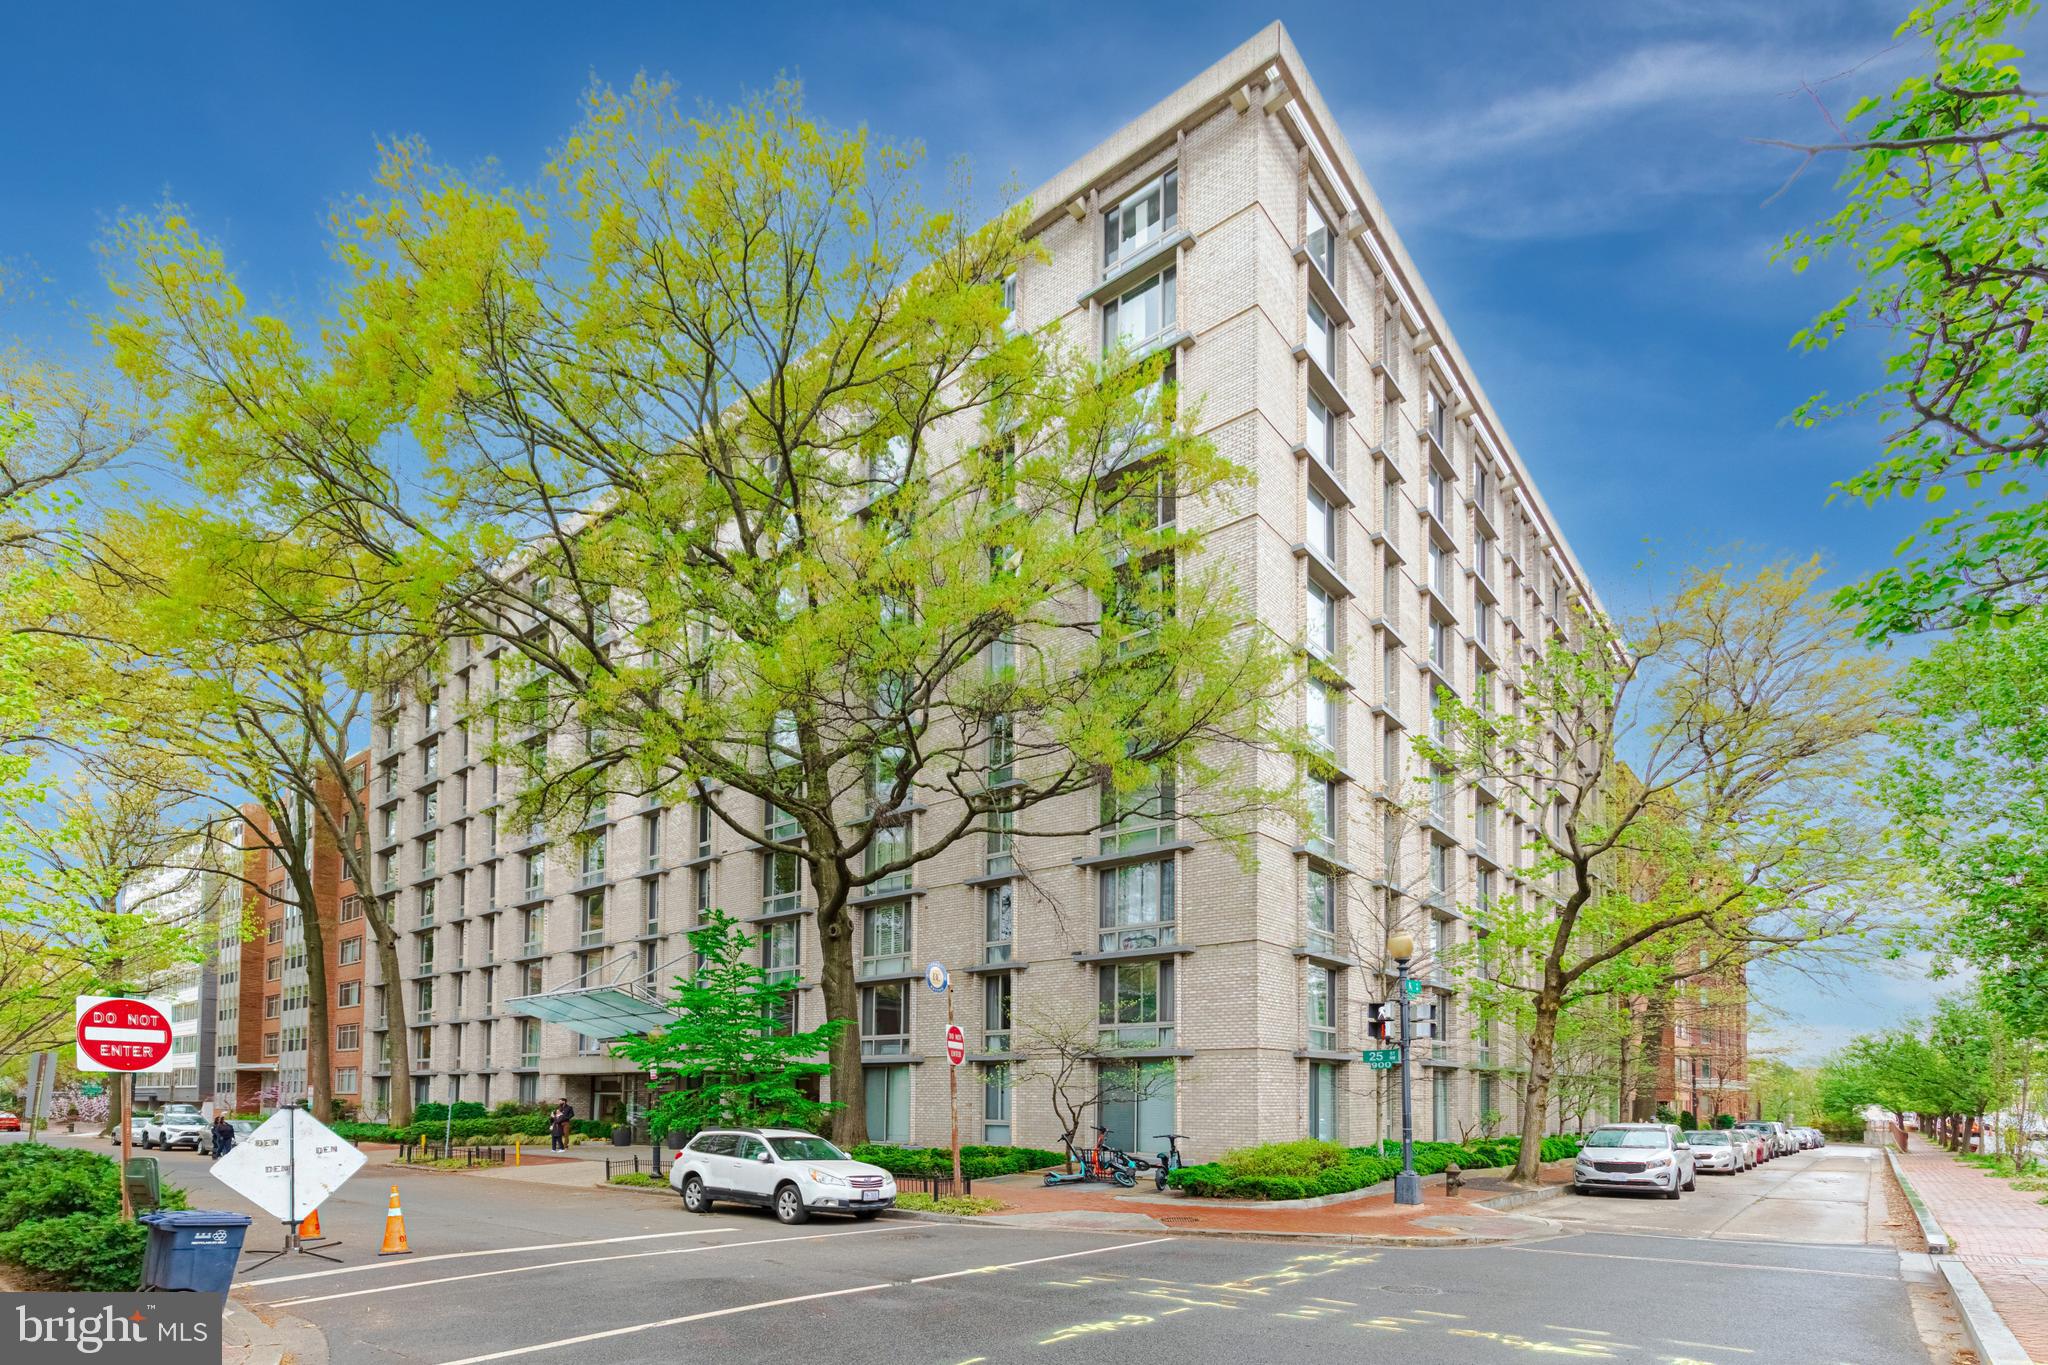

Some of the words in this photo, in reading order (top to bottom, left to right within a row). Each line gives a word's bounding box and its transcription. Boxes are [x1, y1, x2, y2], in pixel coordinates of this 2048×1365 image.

[93, 1011, 117, 1024] DO
[127, 1013, 160, 1026] NOT
[100, 1044, 153, 1057] ENTER
[1369, 1051, 1383, 1061] 25
[316, 1145, 338, 1154] DEN
